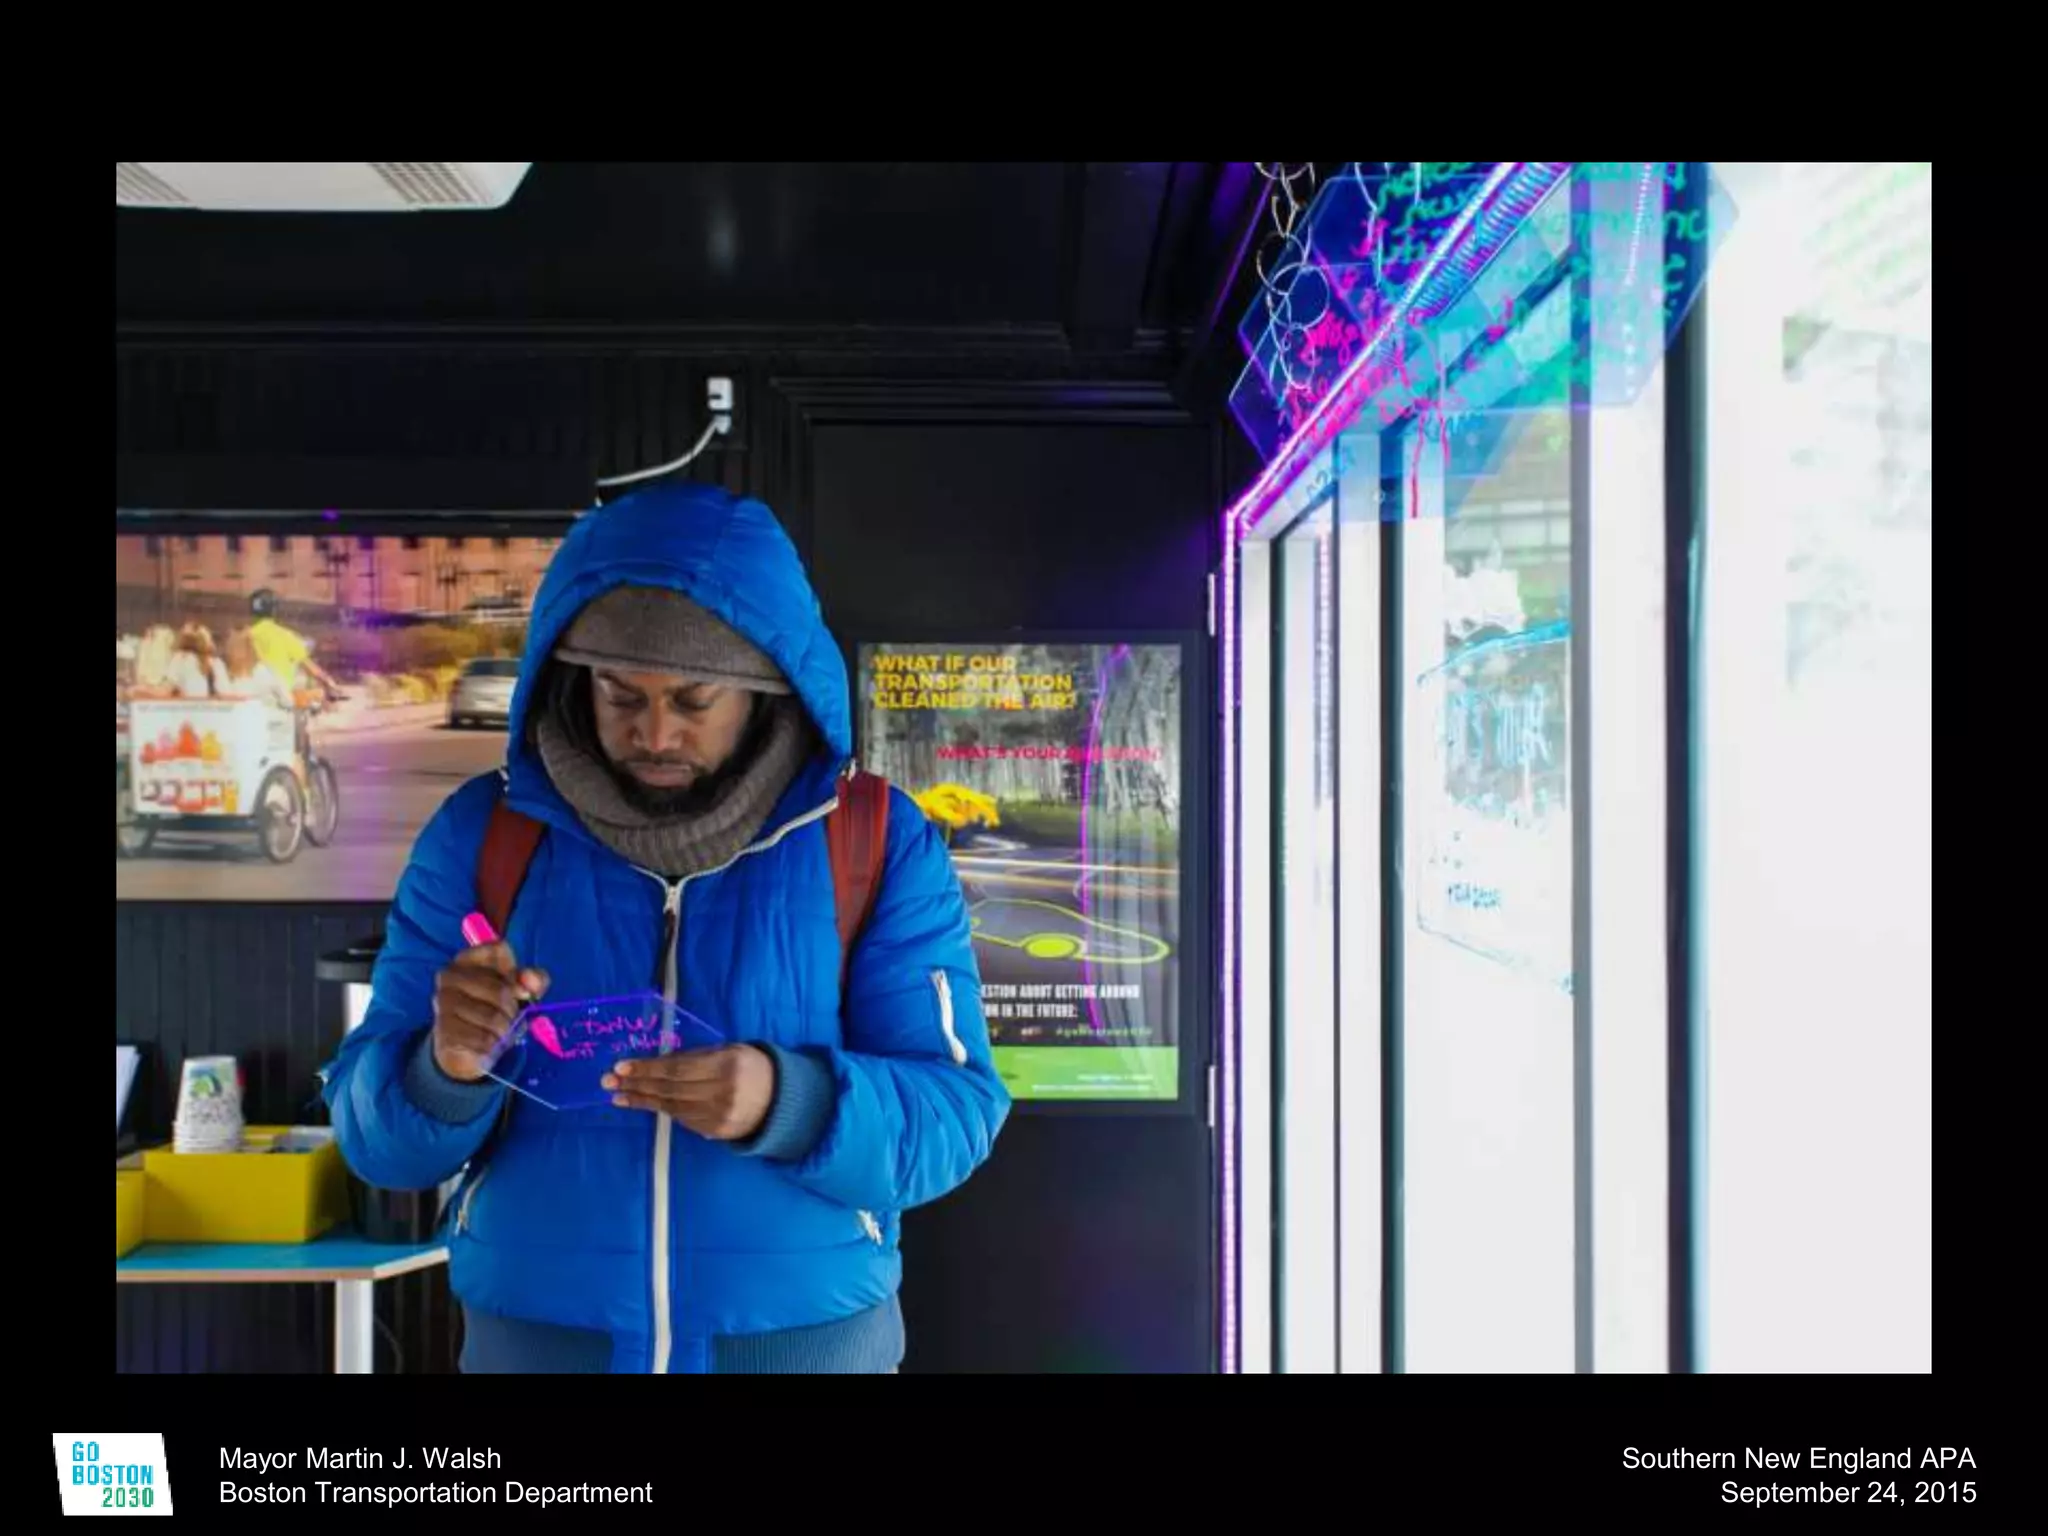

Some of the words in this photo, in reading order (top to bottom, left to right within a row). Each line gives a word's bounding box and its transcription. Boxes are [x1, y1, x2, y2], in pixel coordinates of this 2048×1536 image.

[875, 654, 939, 671] WHAT
[944, 654, 966, 671] IF
[970, 654, 1017, 671] OUR
[875, 673, 1073, 690] TRANSPORTATION
[875, 691, 978, 709] CLEANED
[982, 691, 1024, 709] THE
[1019, 984, 1053, 998] ABOUT
[1055, 984, 1097, 998] GETTING
[1015, 1003, 1035, 1017] THE
